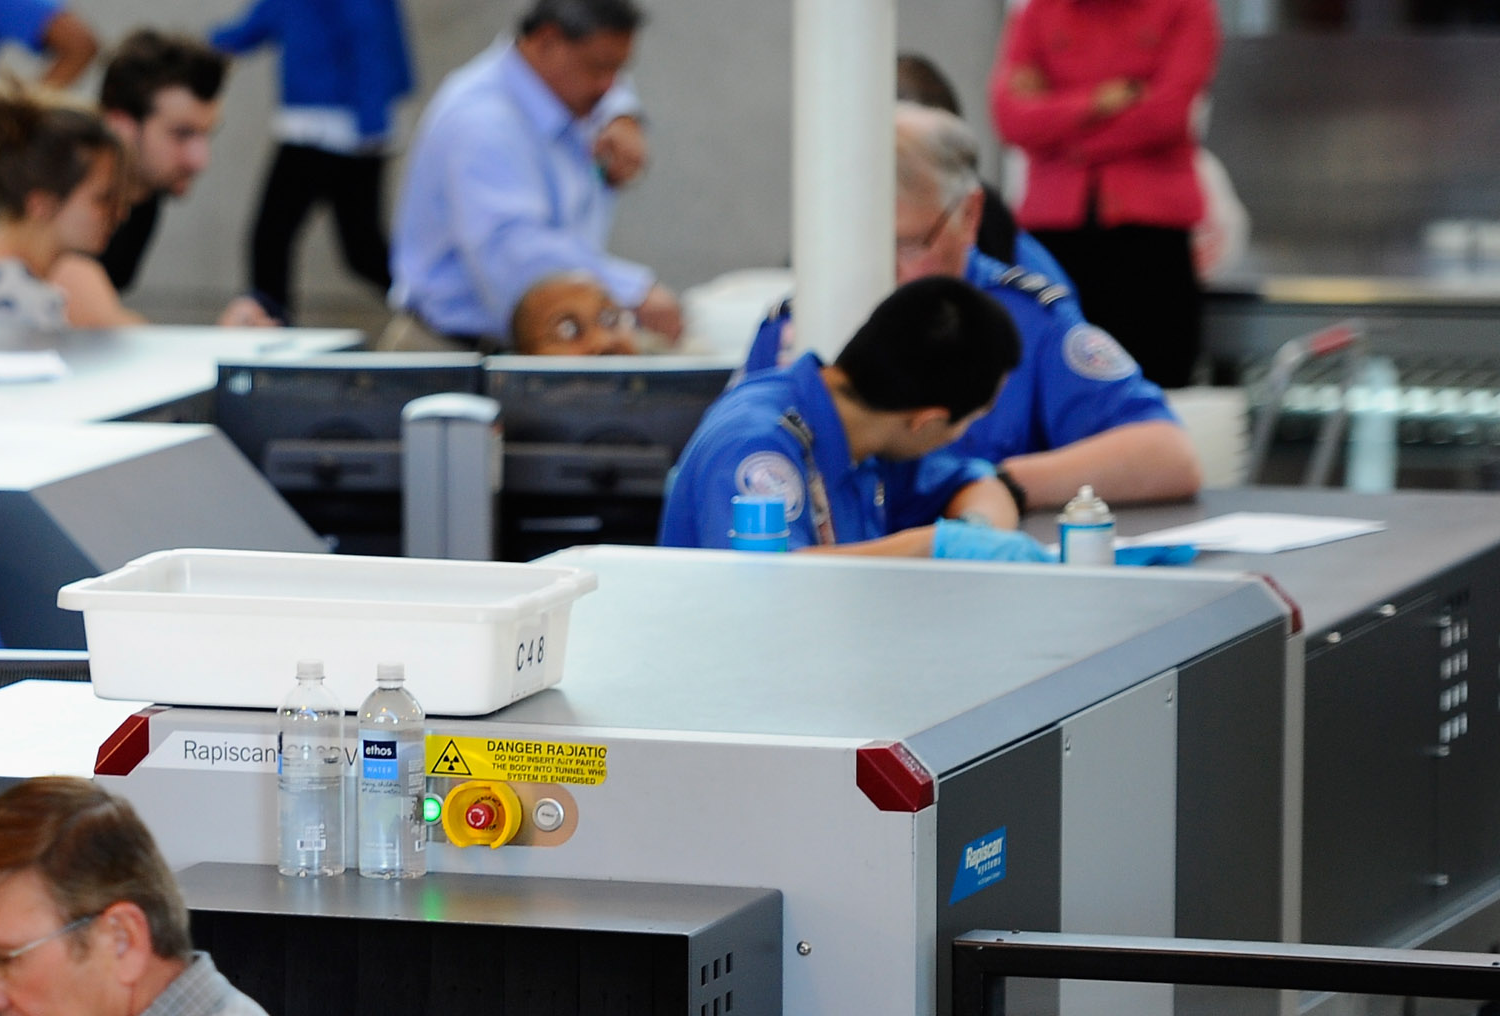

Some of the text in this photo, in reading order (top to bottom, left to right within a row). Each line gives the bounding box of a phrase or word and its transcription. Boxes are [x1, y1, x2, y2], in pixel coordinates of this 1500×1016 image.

[183, 740, 277, 765] Rapiscan
[365, 745, 393, 756] ethos
[487, 740, 542, 754] DANGER
[526, 756, 555, 764] INSERT
[575, 759, 596, 767] PART
[509, 763, 532, 772] BODY
[533, 765, 552, 773] INTO
[555, 767, 585, 775] TUNNEL
[507, 773, 539, 782] SYSTEM
[550, 776, 597, 785] ENERGISED
[965, 837, 1004, 870] Rapiscan
